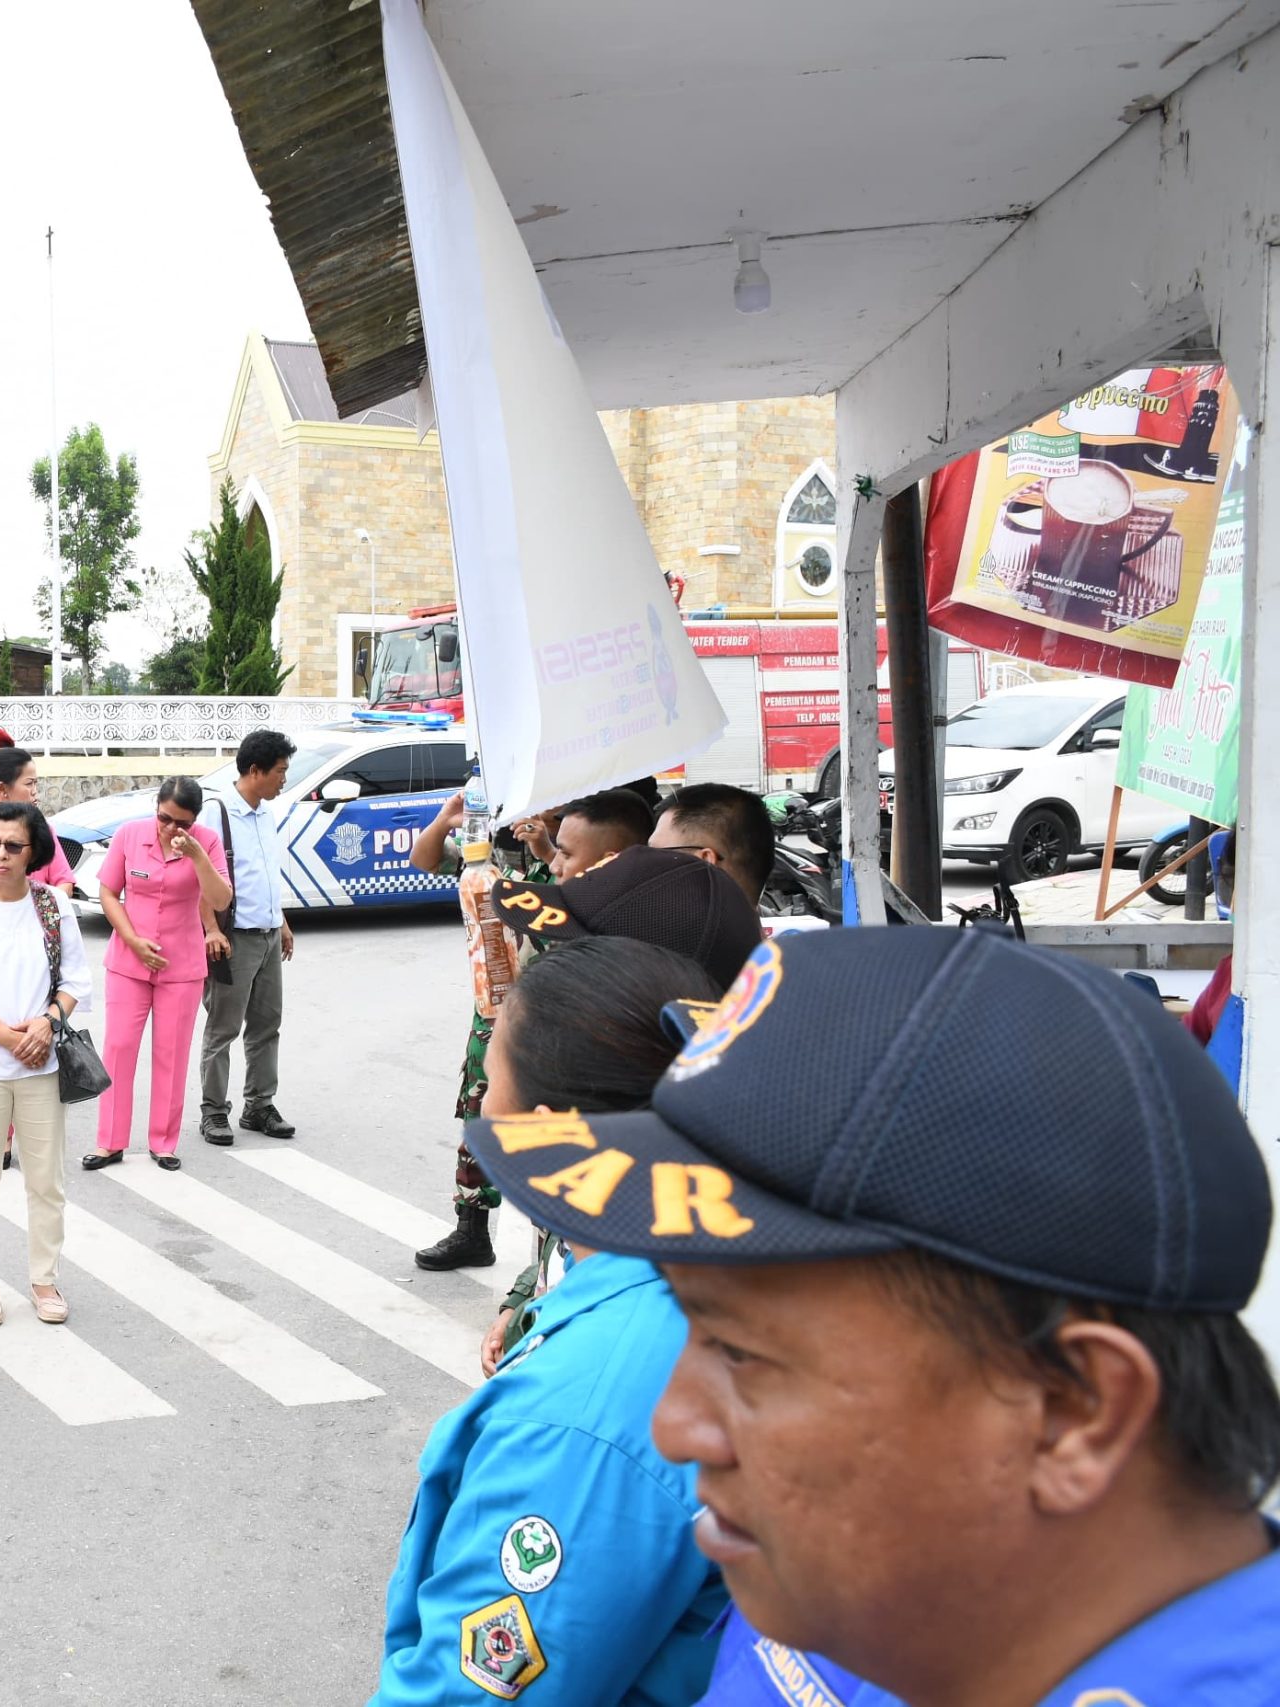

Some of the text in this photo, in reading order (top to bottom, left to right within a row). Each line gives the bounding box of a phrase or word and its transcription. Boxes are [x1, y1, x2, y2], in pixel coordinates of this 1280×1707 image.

[1075, 384, 1169, 415] ppuccino
[1011, 435, 1030, 451] USE
[1032, 571, 1117, 598] CREAMY CAPPUCCINO
[717, 635, 750, 647] TENDER
[784, 656, 824, 667] PEMADAM
[765, 693, 840, 706] PEMERINTAH KABUP
[796, 713, 817, 723] TELP.
[373, 827, 420, 855] POL
[373, 859, 411, 871] LALU
